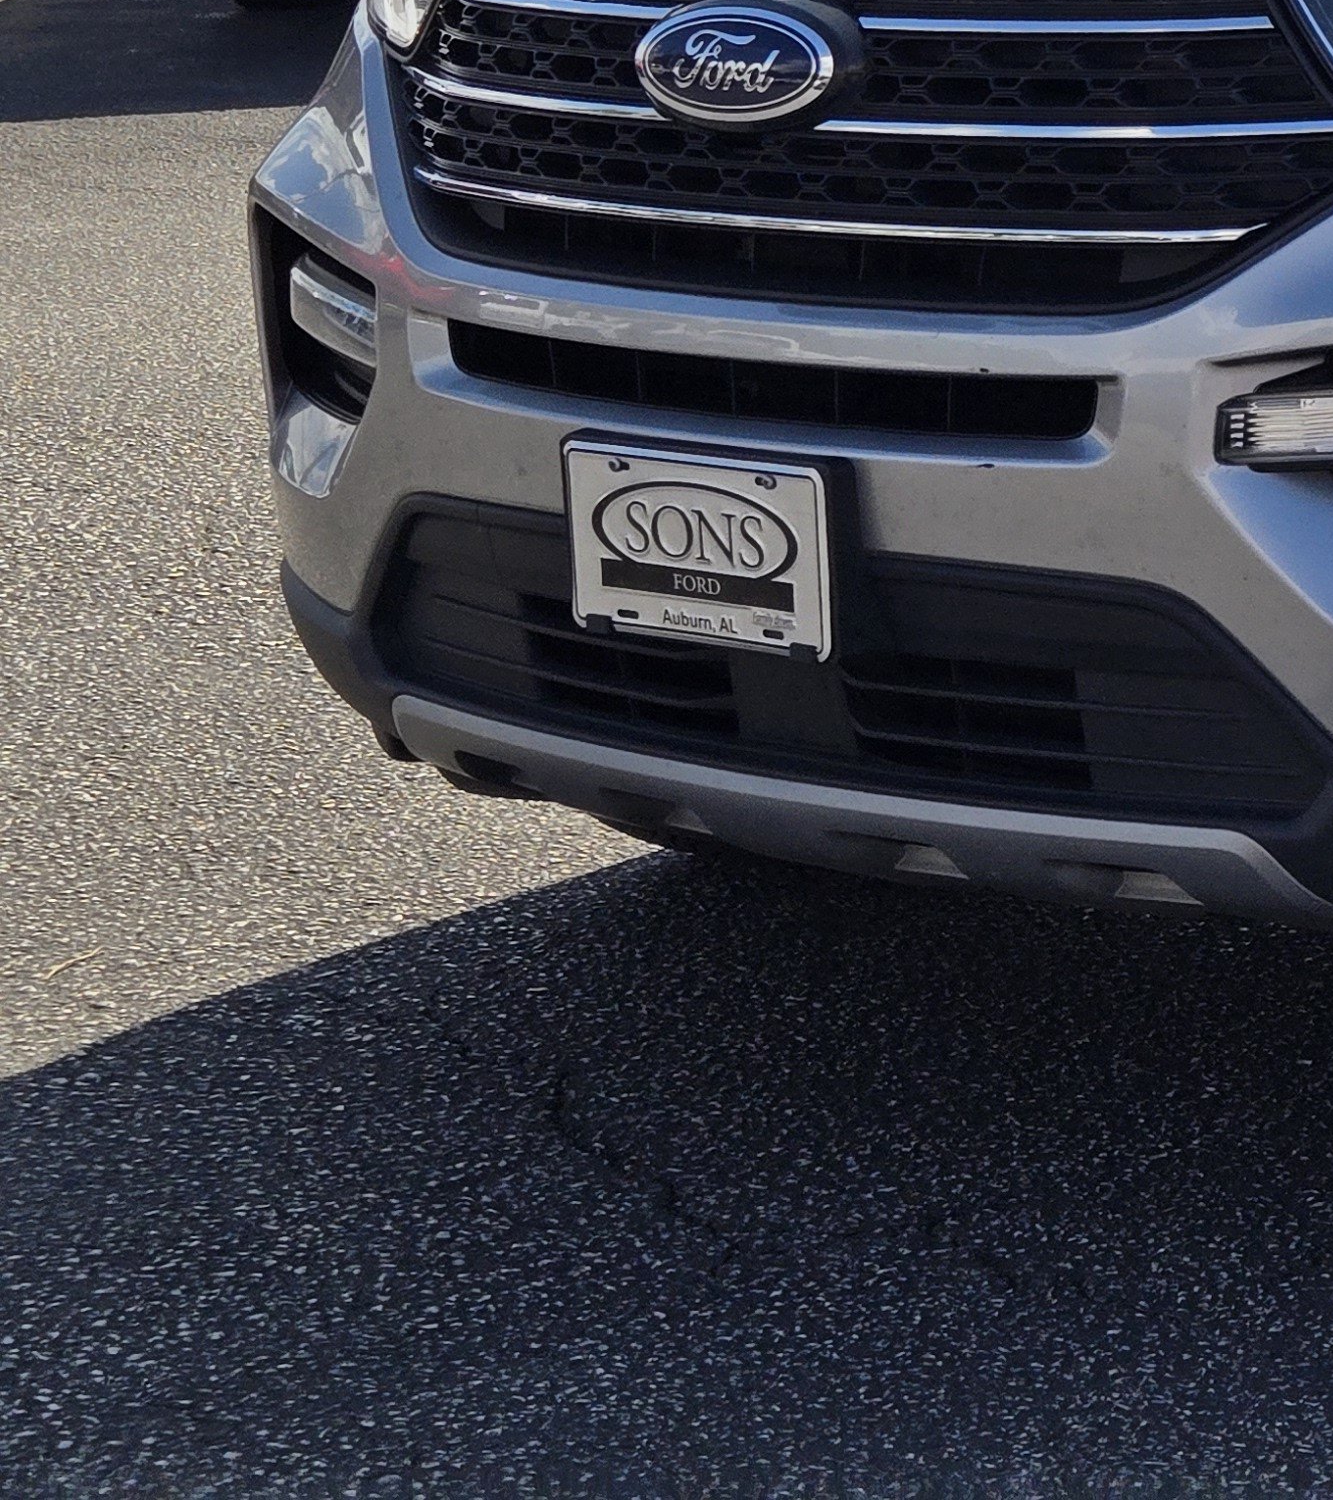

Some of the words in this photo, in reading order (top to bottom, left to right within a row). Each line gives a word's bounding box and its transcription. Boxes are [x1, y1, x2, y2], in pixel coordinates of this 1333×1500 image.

[672, 29, 781, 94] Ford
[624, 500, 766, 569] SONS
[672, 573, 722, 596] FORD
[662, 608, 717, 634] Auburn,
[718, 617, 738, 635] AL
